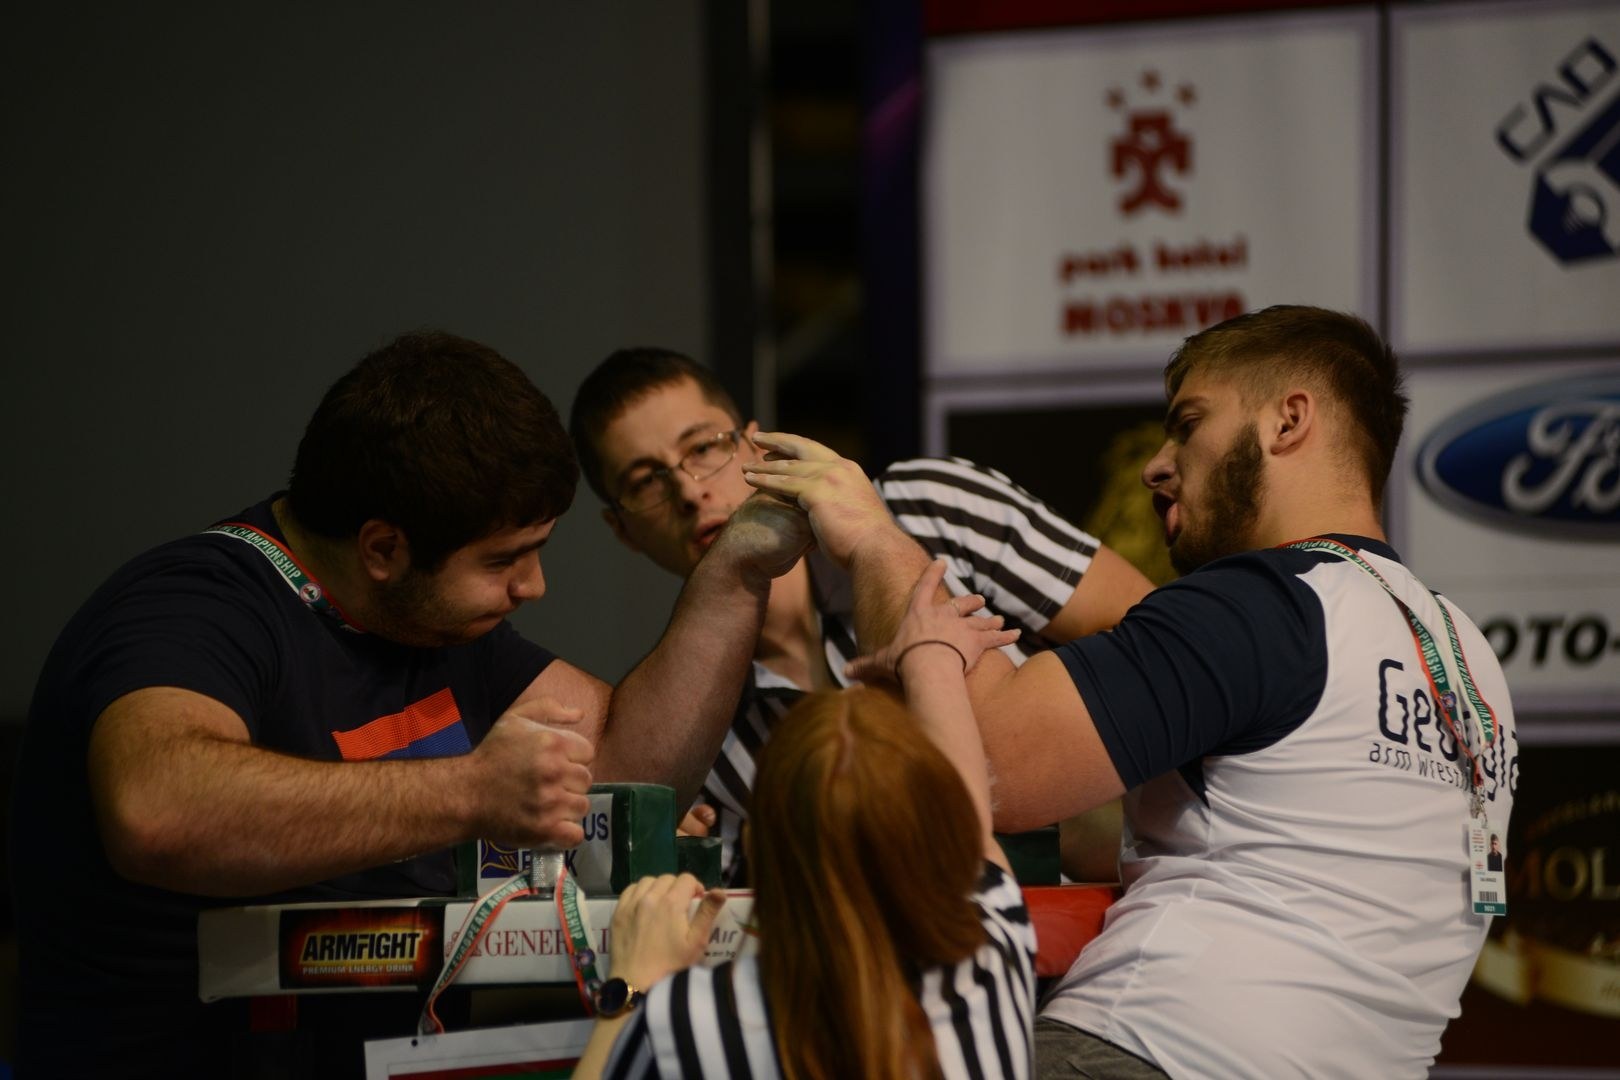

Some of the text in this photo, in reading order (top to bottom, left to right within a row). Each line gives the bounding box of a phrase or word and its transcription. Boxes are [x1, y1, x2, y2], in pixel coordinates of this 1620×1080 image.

[233, 526, 302, 579] CHAMPIONSHIP
[1369, 742, 1413, 771] arm
[302, 931, 421, 962] ARMFIGHT
[303, 964, 415, 975] PREMIUM ENERGY DRINK
